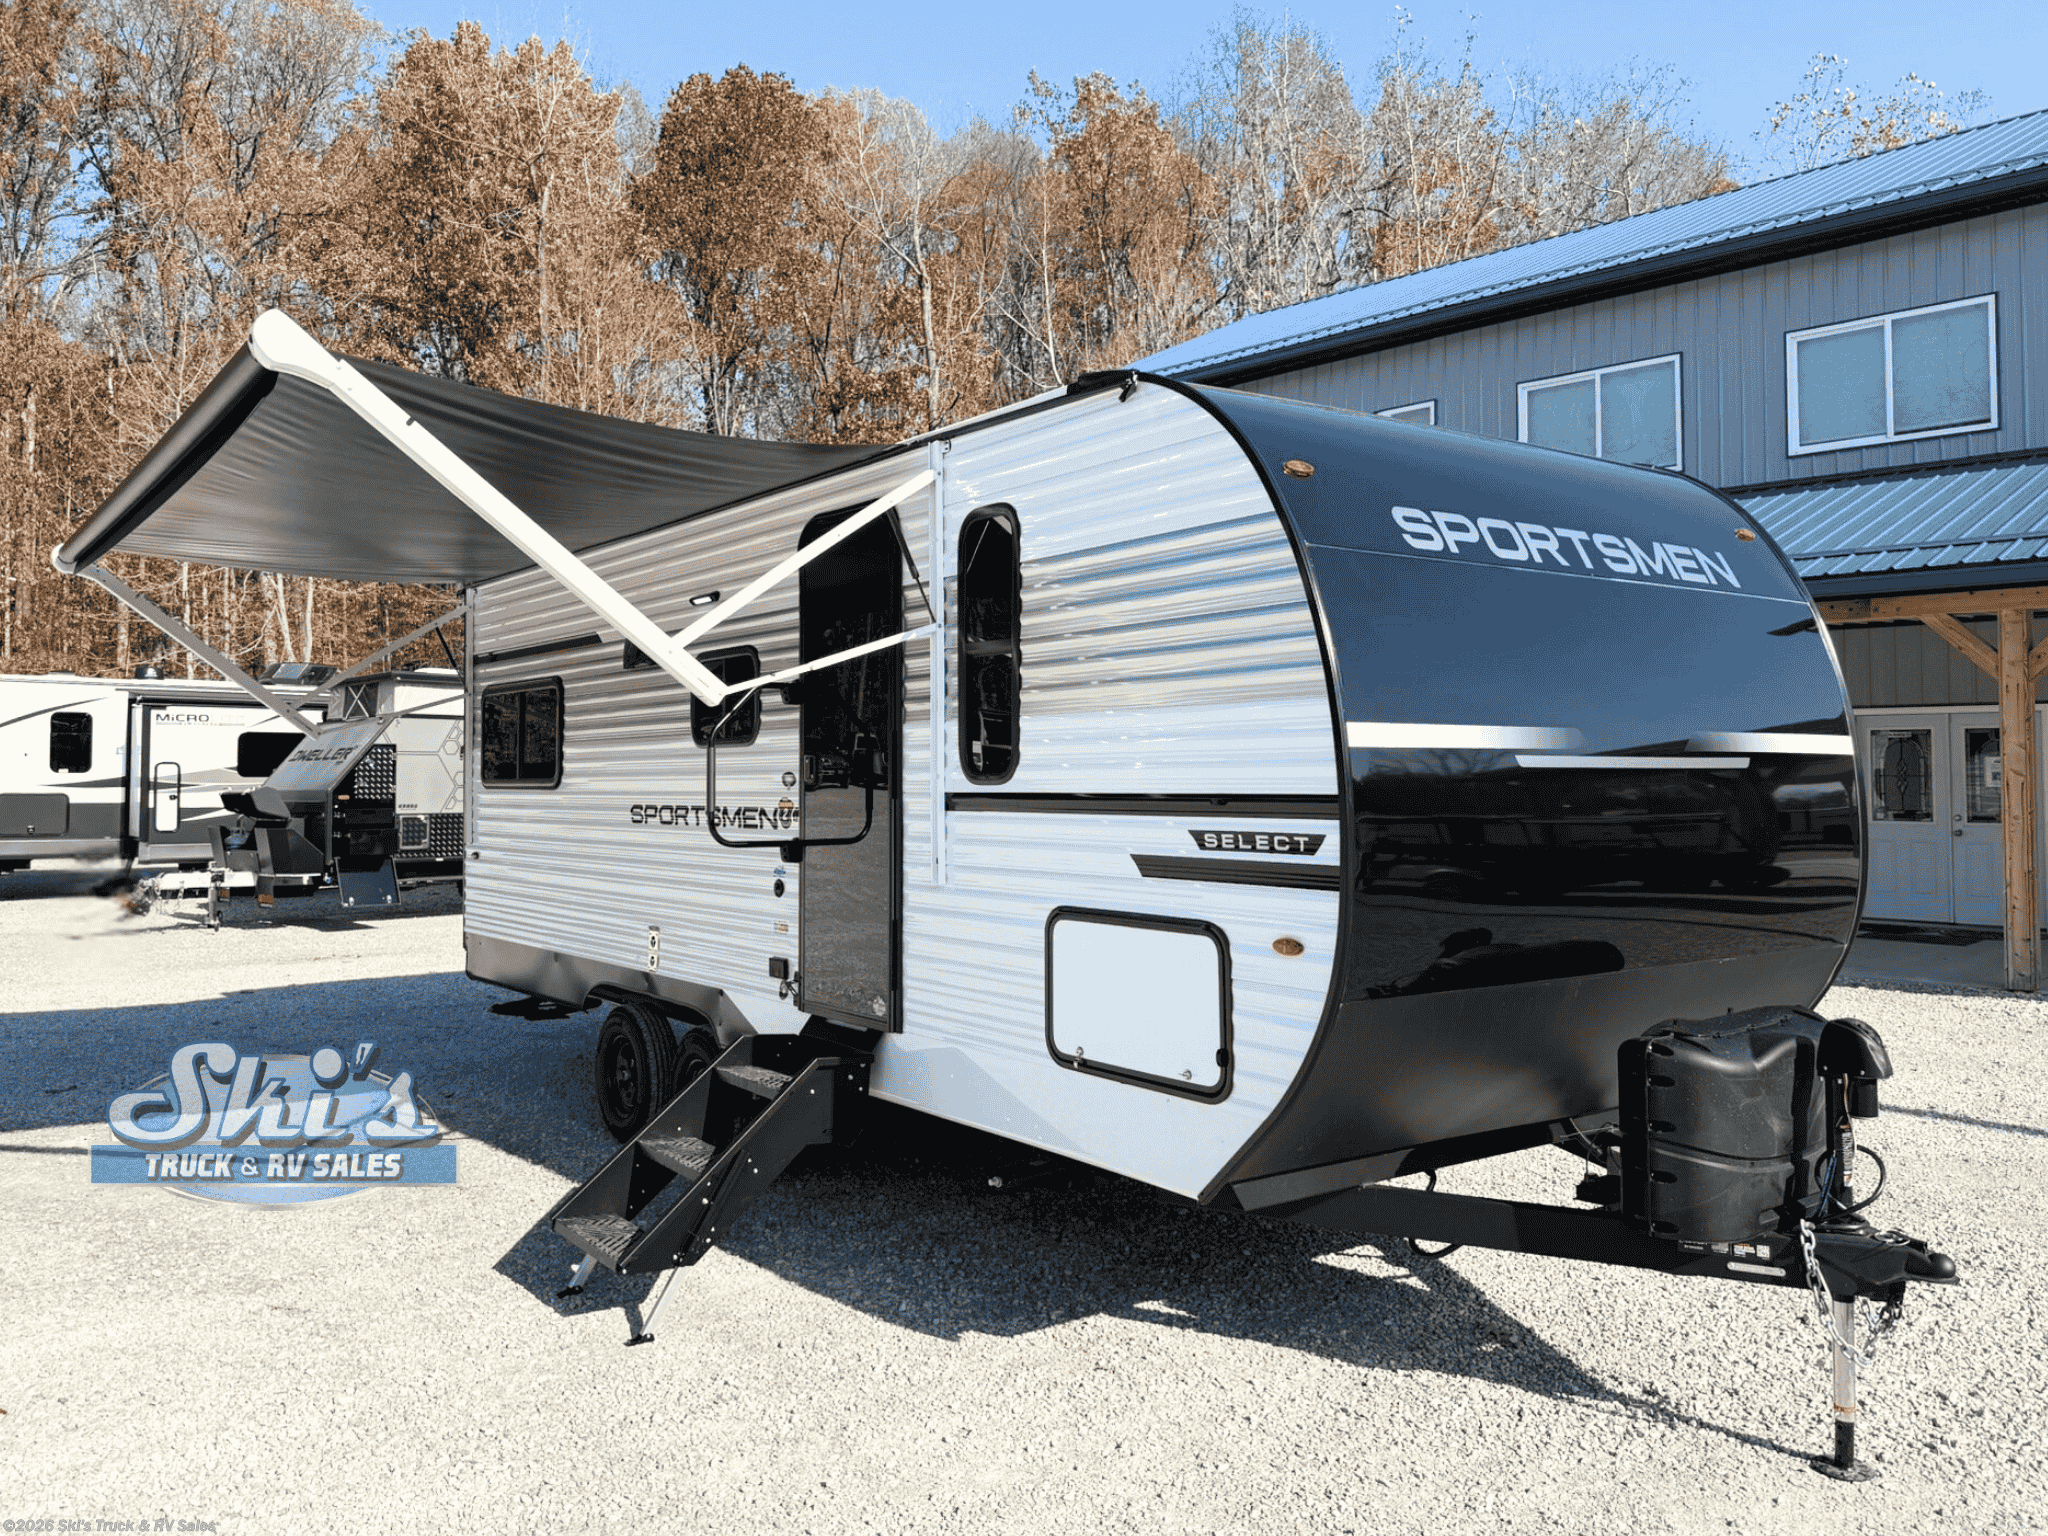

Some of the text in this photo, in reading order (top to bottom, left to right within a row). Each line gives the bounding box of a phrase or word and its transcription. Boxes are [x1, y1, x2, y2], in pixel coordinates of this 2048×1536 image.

[1391, 506, 1741, 588] SPORTSMEN
[630, 804, 778, 830] SPORTSMEN
[1203, 832, 1310, 853] SELECT
